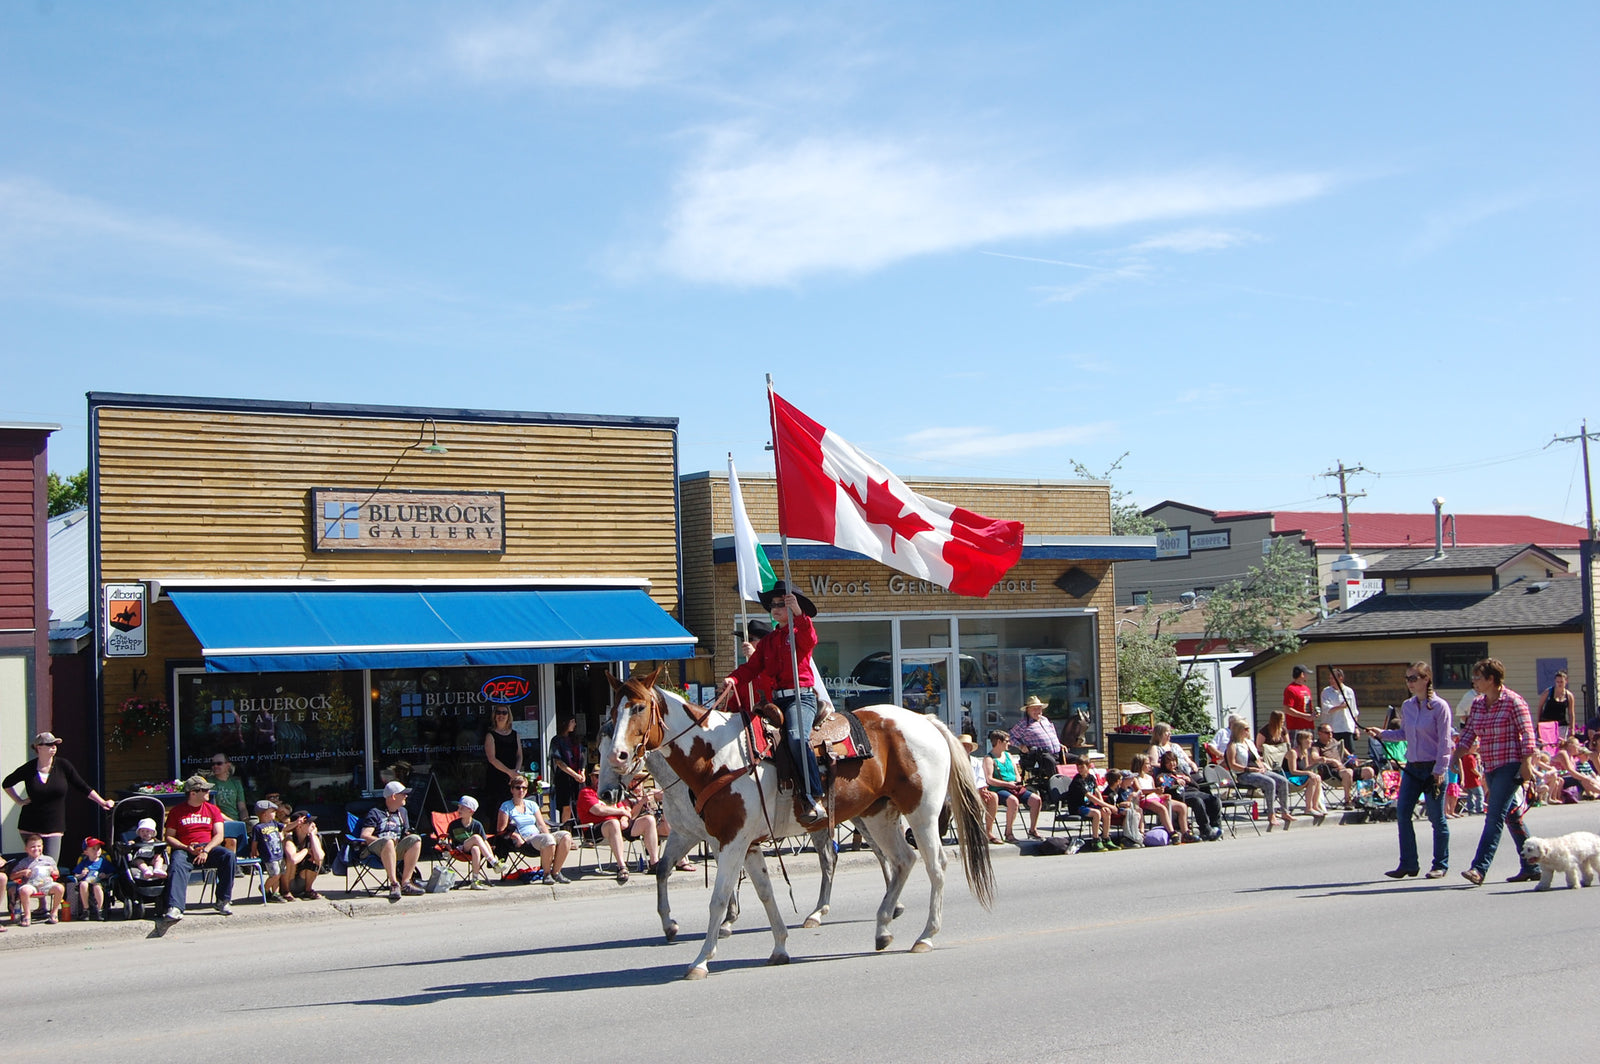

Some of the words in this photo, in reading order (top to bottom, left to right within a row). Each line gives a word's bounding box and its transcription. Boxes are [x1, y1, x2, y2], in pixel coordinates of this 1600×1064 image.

[369, 504, 495, 524] BLUEROCK
[369, 525, 495, 539] GALLERY
[1159, 538, 1181, 550] 2007
[888, 574, 953, 595] GENER
[109, 588, 142, 599] Alberta
[1348, 590, 1377, 599] PIZZ
[110, 638, 143, 647] Cowboy
[114, 644, 136, 652] Trail
[483, 680, 530, 697] OPEN
[240, 696, 333, 712] BLUEROCK
[425, 690, 511, 706] BLUEROCK
[425, 704, 512, 717] GALLE
[240, 711, 333, 724] GALLERY
[187, 755, 202, 764] fine
[228, 755, 249, 764] ottery
[256, 752, 284, 763] jewelry
[290, 750, 310, 759] cards
[315, 748, 332, 760] gifts
[337, 747, 360, 757] books
[386, 746, 400, 755] fine
[402, 744, 418, 754] craft
